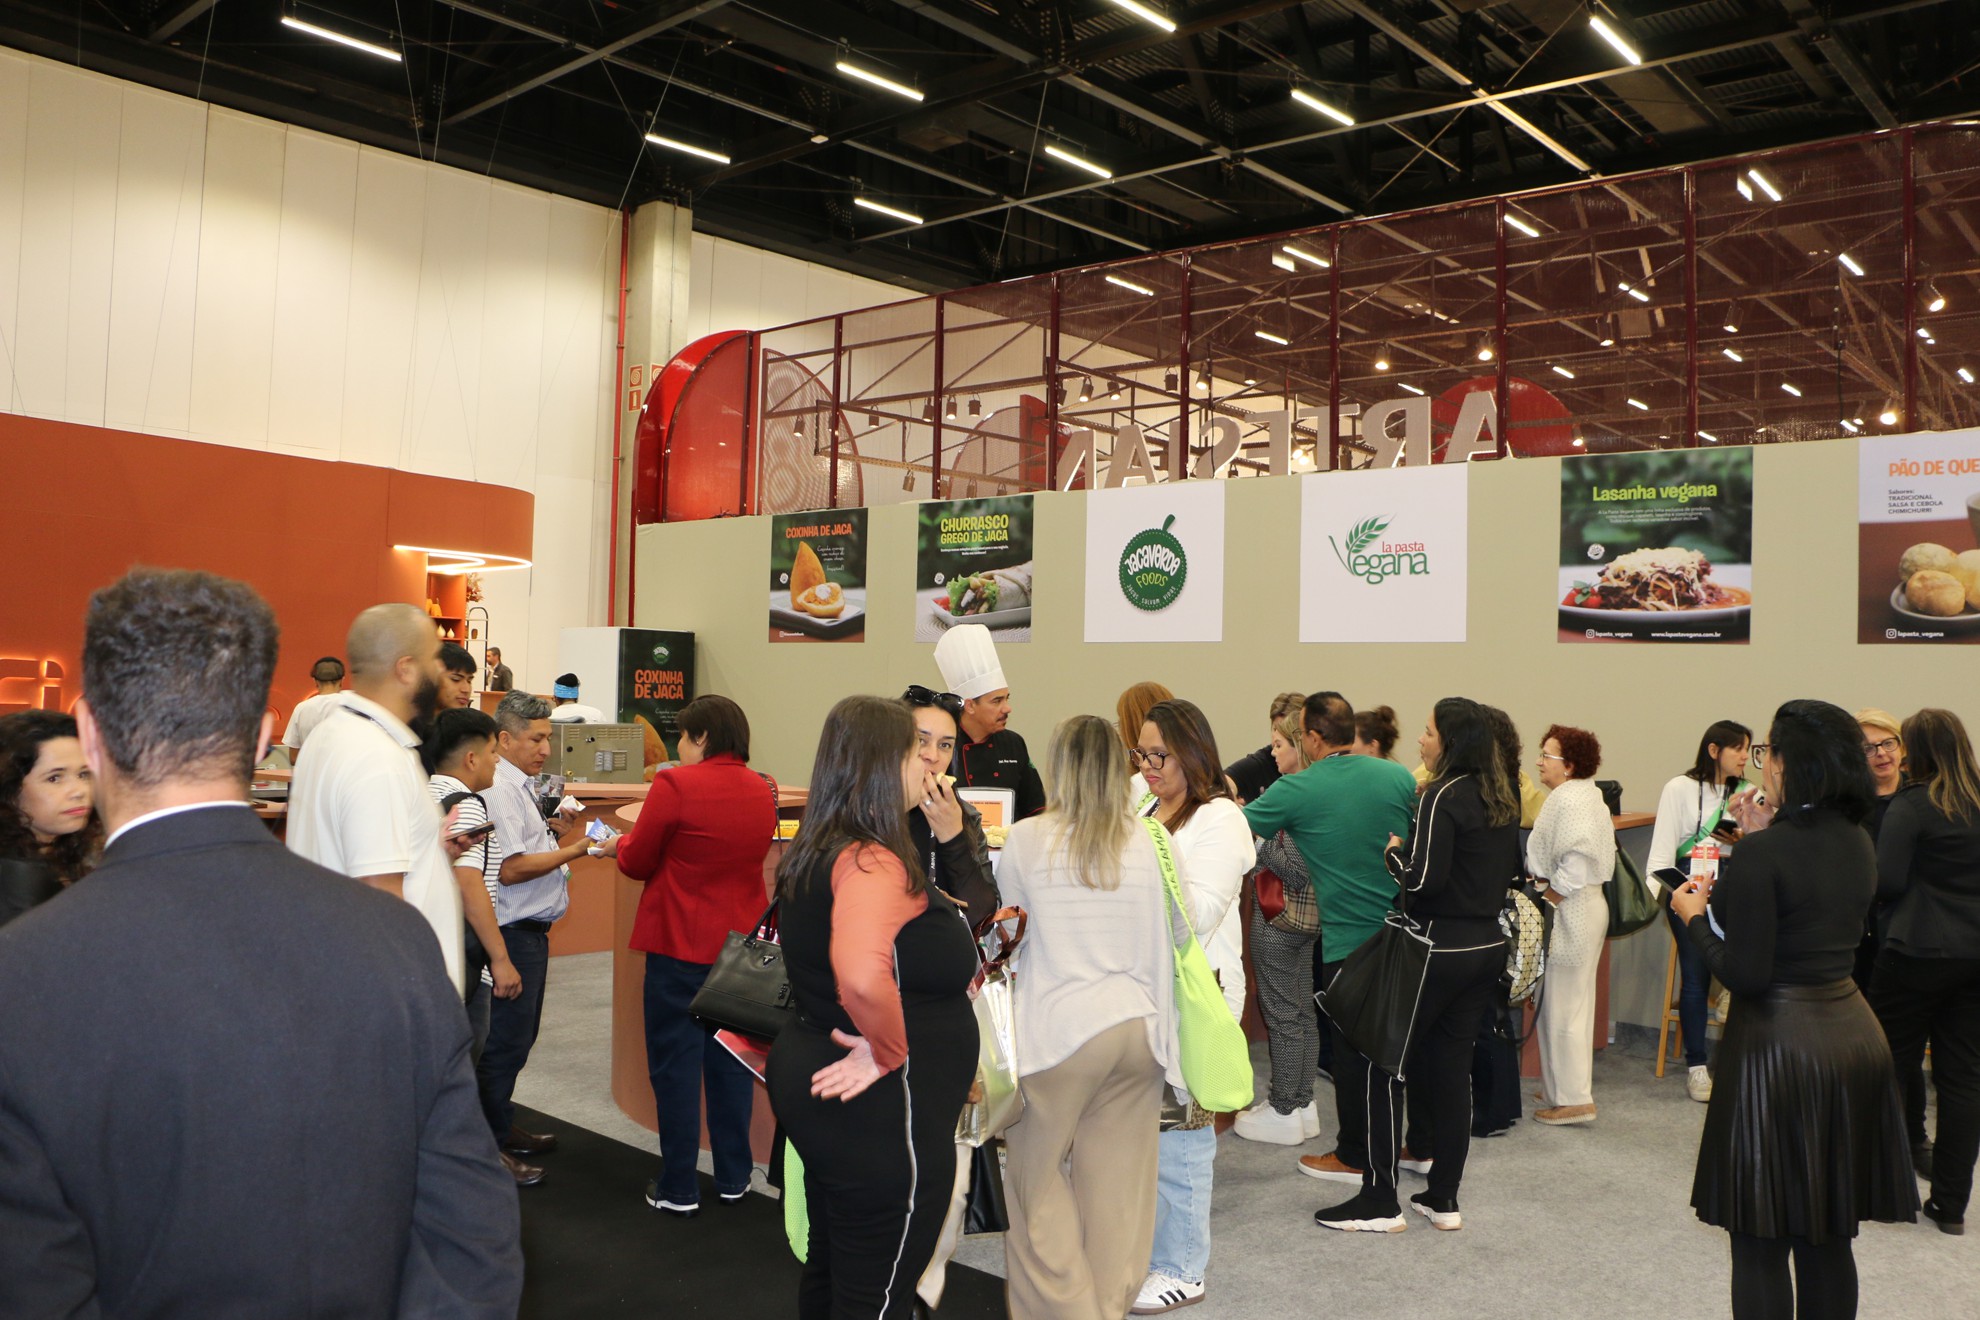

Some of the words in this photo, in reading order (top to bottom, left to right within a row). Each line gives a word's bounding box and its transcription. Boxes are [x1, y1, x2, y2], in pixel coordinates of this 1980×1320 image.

[1889, 458, 1920, 477] PÃO
[1923, 460, 1945, 475] DE
[1593, 485, 1656, 501] Lasanha
[1660, 482, 1718, 503] vegana
[786, 525, 819, 538] COXINHA
[820, 525, 831, 536] DE
[832, 523, 852, 535] JACA
[941, 514, 1009, 532] CHURRASCO
[941, 532, 969, 544] GREGO
[971, 531, 983, 543] DE
[985, 529, 1008, 542] JACA
[1382, 541, 1392, 553] la
[1395, 541, 1424, 555] pasta
[1136, 572, 1168, 588] FOODS
[1898, 630, 1944, 638] lapasta_vegana
[635, 669, 684, 685] COXINHA
[634, 683, 651, 699] DE
[653, 684, 684, 700] JACA
